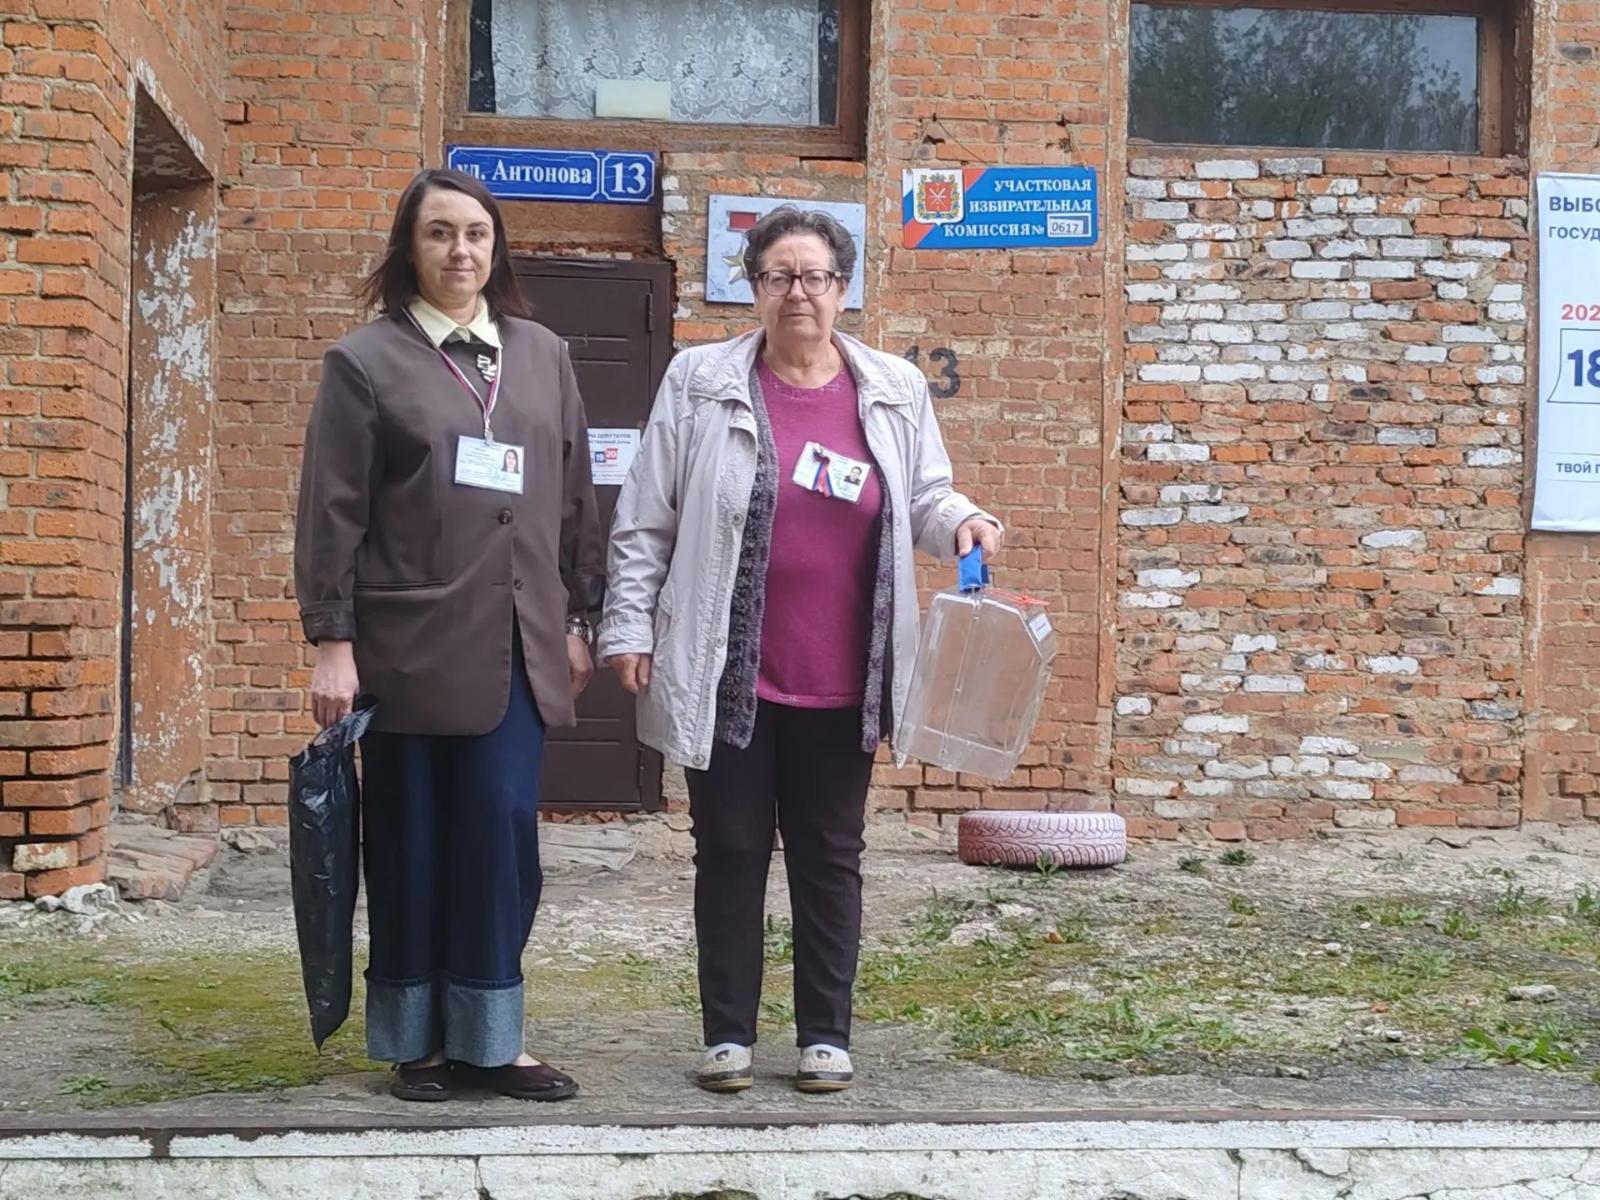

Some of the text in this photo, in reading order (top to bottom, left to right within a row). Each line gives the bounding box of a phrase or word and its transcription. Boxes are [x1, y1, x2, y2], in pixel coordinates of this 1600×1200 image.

[492, 159, 592, 185] Антонова
[612, 162, 647, 194] 13
[994, 179, 1092, 193] УЧАСТКОВАЯ
[969, 199, 1092, 213] ИЗБИРАТЕЛЬНАЯ
[1051, 221, 1080, 234] 0617
[1561, 303, 1600, 321] 202
[1556, 461, 1591, 473] ТВОЙ
